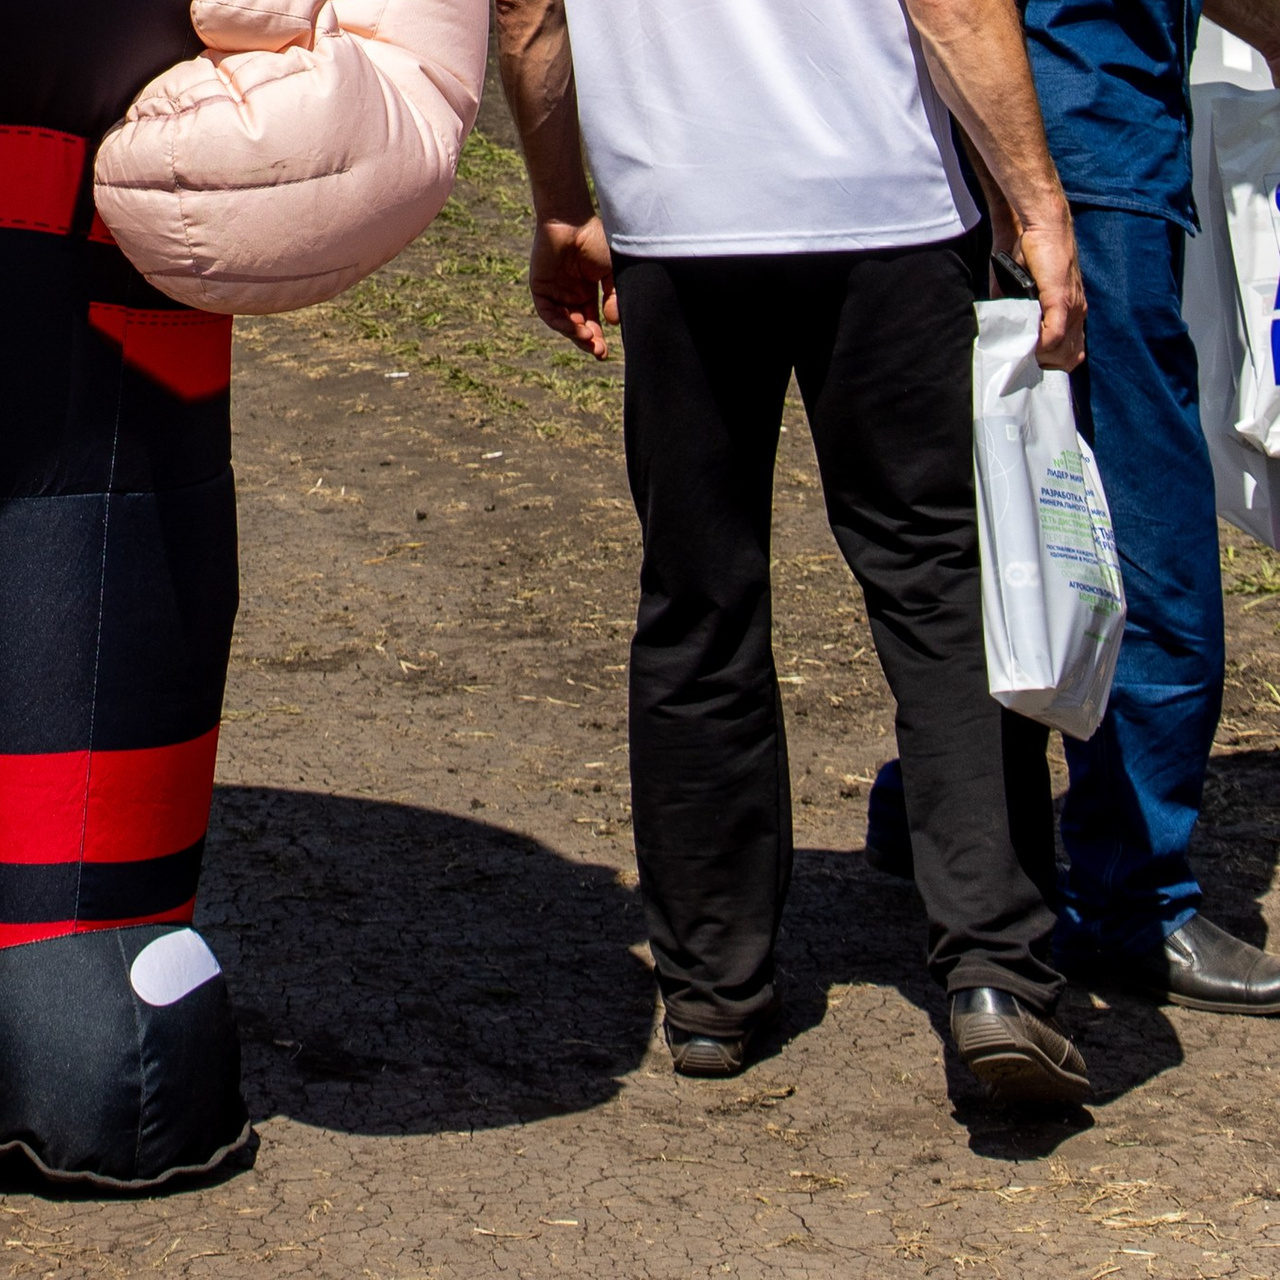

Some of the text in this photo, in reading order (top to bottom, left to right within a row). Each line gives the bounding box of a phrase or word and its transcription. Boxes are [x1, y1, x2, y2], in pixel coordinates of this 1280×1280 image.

[1046, 468, 1069, 480] ЛИДЕР
[1041, 487, 1083, 503] РАЗРАБОТКА
[1039, 497, 1086, 513] МИНЕРАЛЬНОГО
